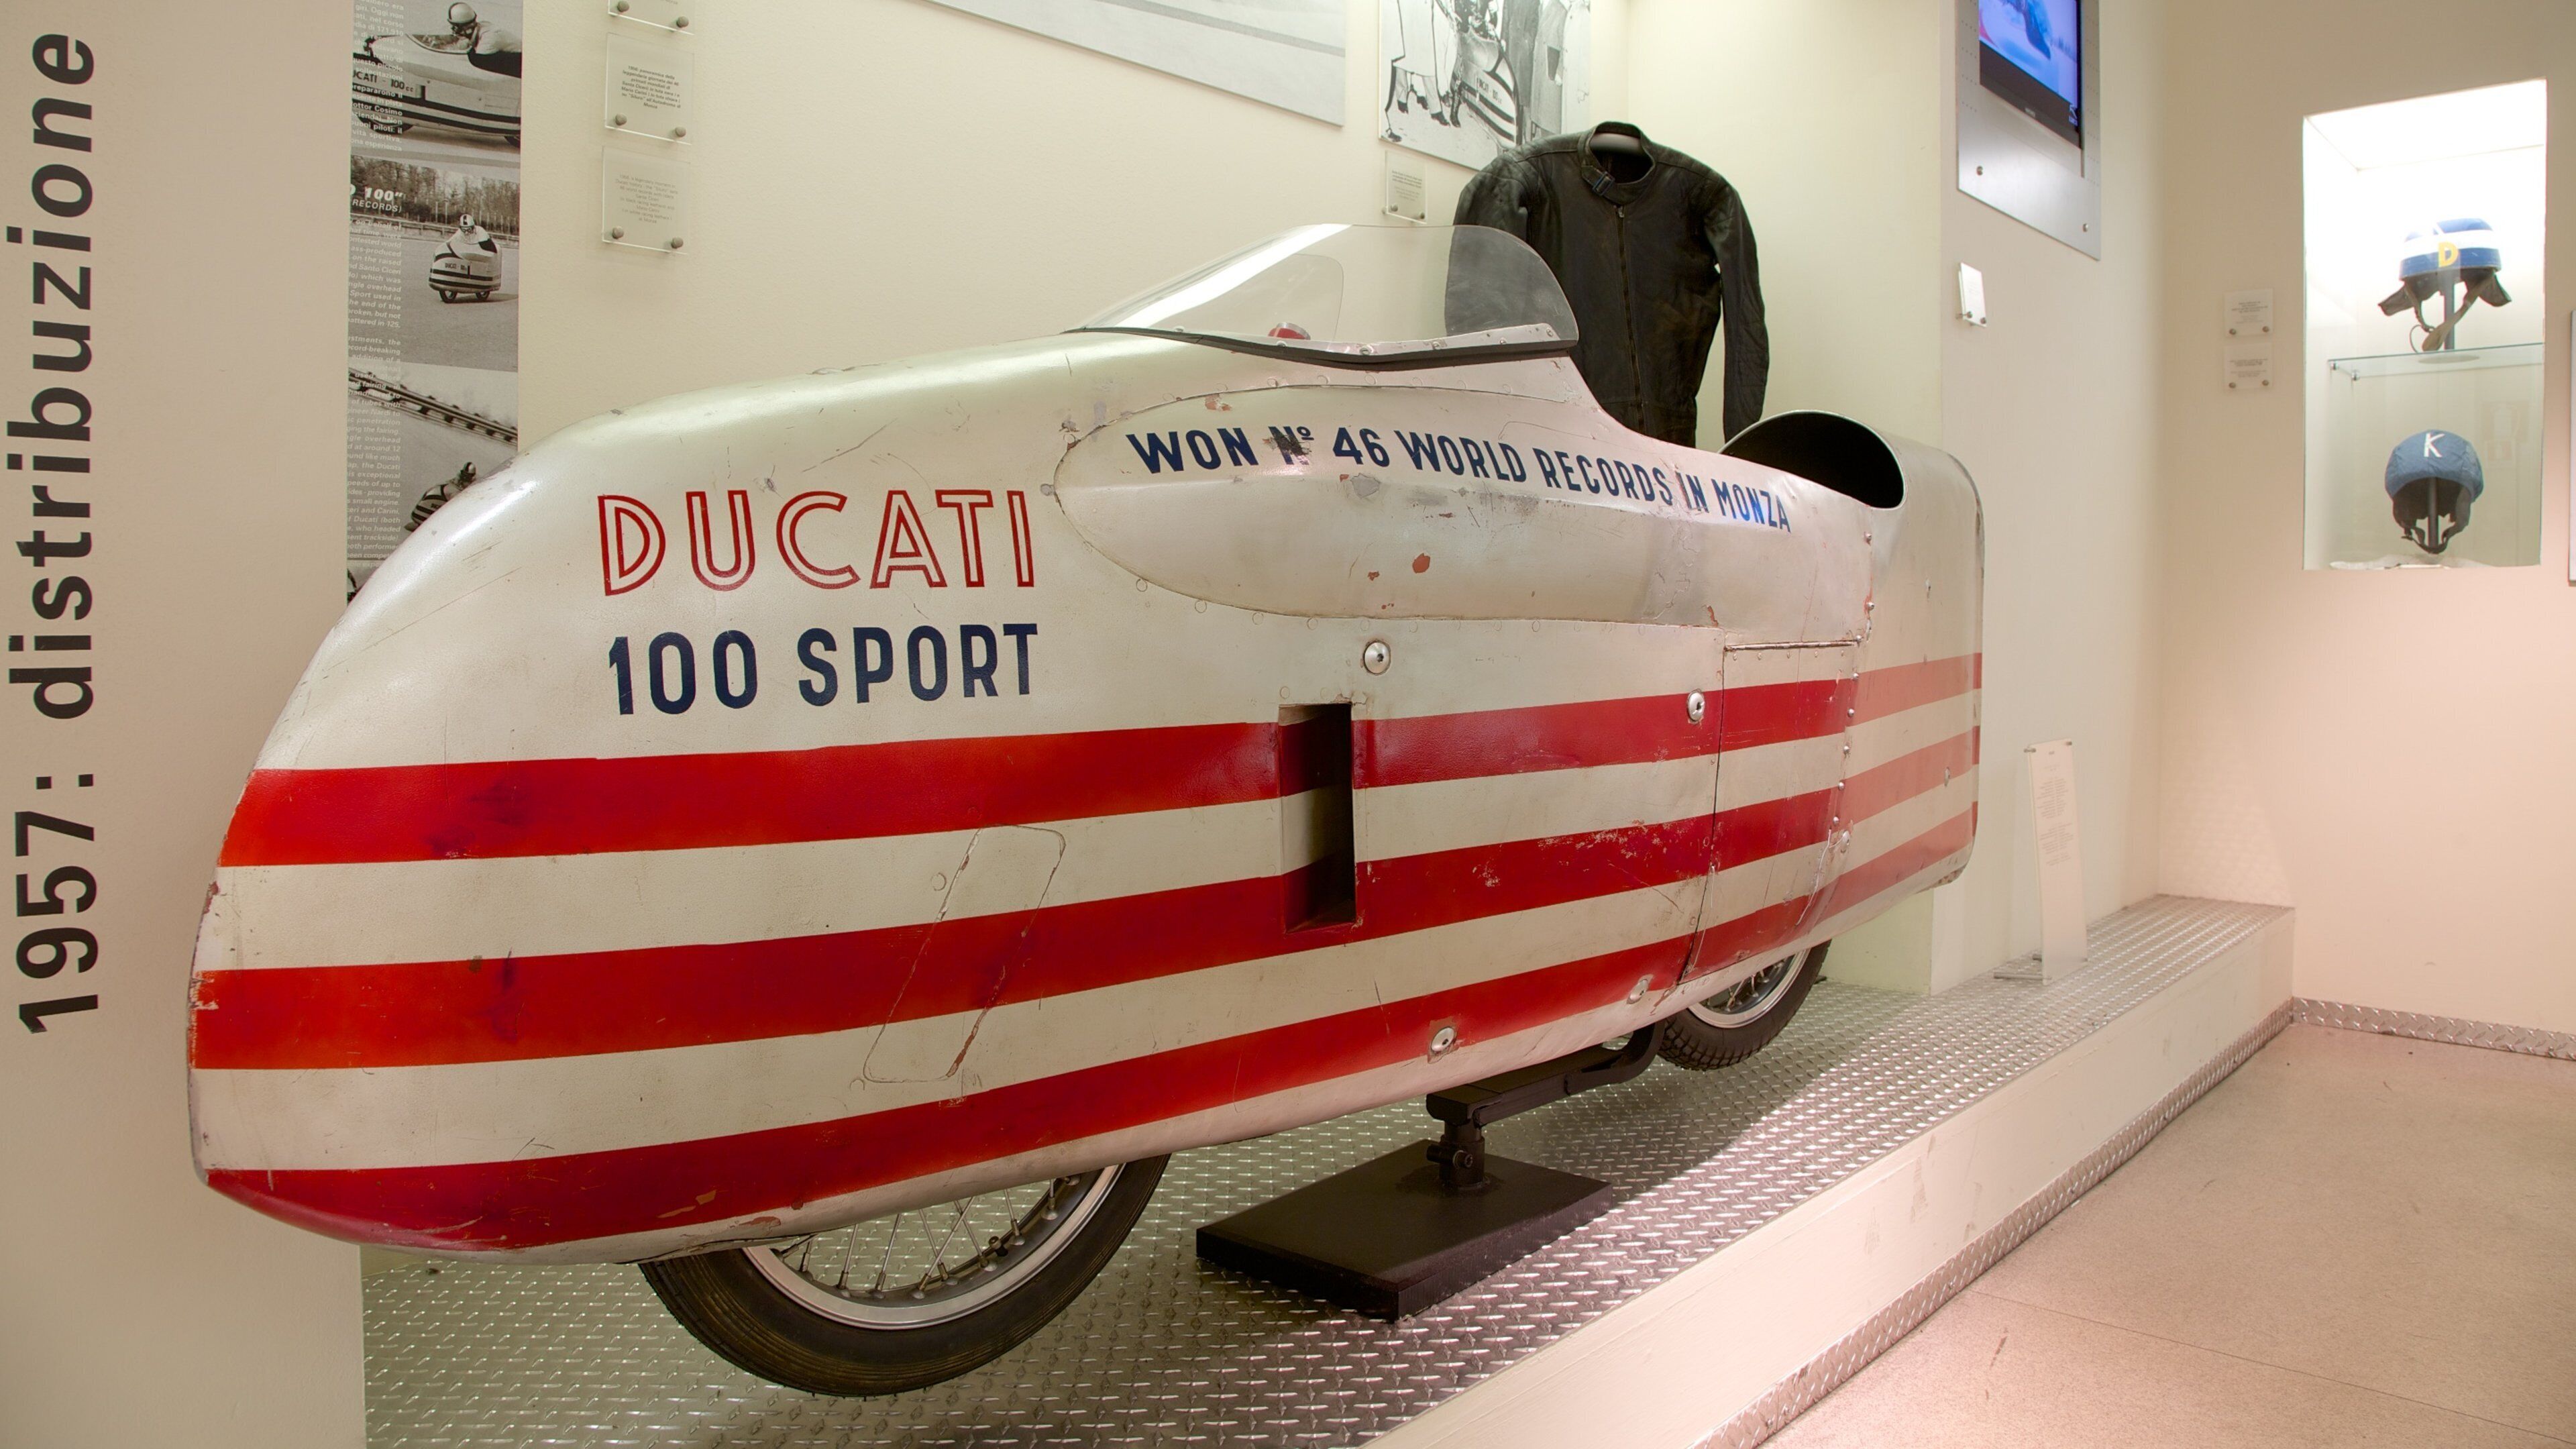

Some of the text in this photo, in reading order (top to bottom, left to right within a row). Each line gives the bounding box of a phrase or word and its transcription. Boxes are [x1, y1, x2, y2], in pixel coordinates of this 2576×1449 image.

[374, 105, 403, 116] Cosimo
[352, 199, 402, 213] RECORDS)
[2438, 241, 2459, 268] D
[350, 289, 372, 298] Sport
[367, 284, 401, 292] overhead
[7, 34, 93, 718] distribuzione
[2424, 433, 2445, 458] K
[1126, 427, 1258, 474] WON
[1333, 427, 1390, 467] 46
[1393, 430, 1527, 482] WORLD
[1532, 447, 1672, 506] RECORDS
[1675, 472, 1709, 513] IN
[1711, 478, 1791, 533] MONZA
[598, 489, 1035, 596] DUCATI
[608, 623, 1038, 715] 100 SPORT
